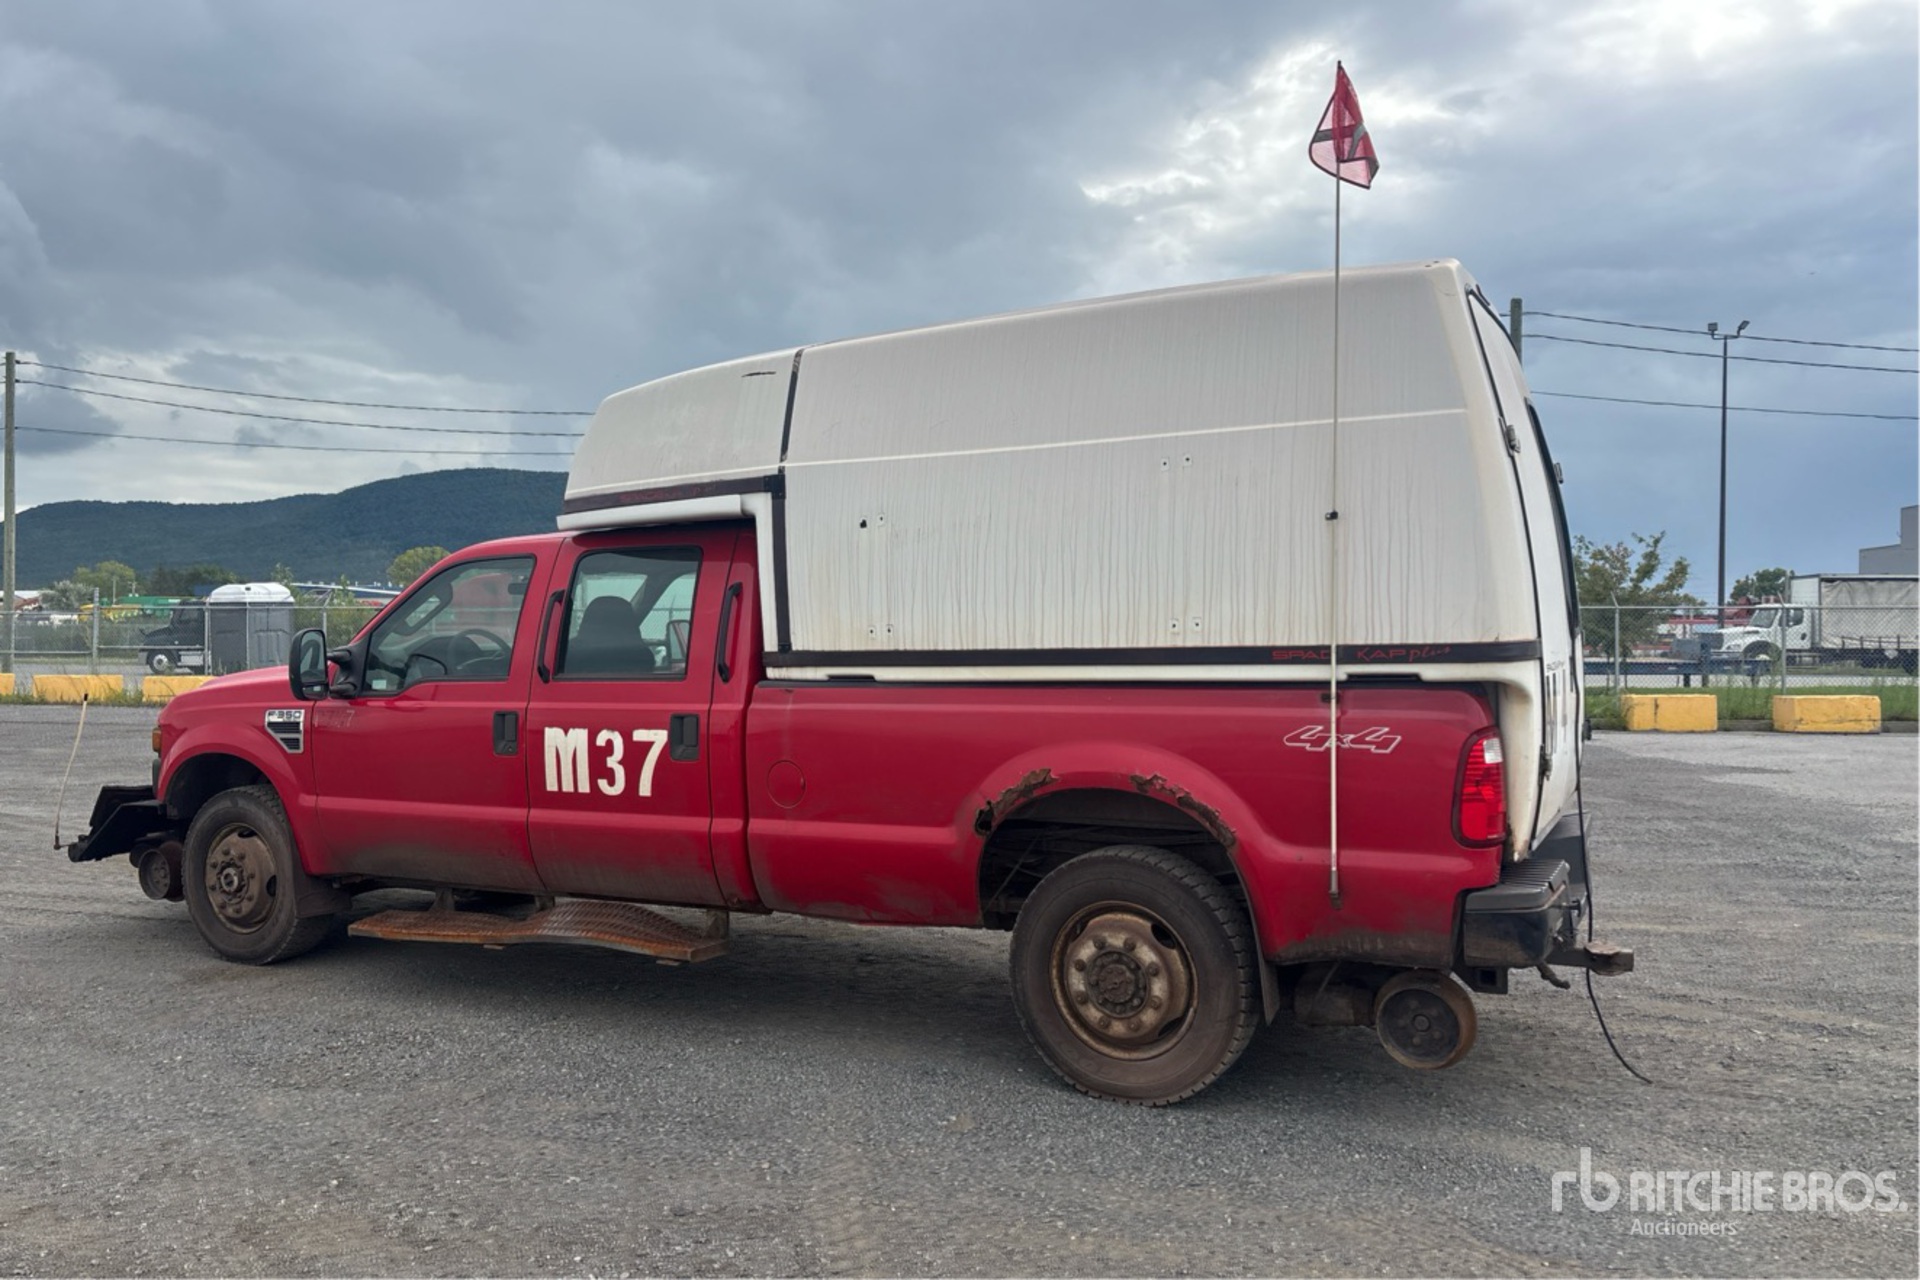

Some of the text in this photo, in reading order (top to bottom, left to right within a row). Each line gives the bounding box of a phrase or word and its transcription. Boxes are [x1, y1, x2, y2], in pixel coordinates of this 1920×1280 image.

[1272, 649, 1337, 661] SPAC
[1356, 647, 1407, 662] KAP
[544, 726, 669, 797] M37
